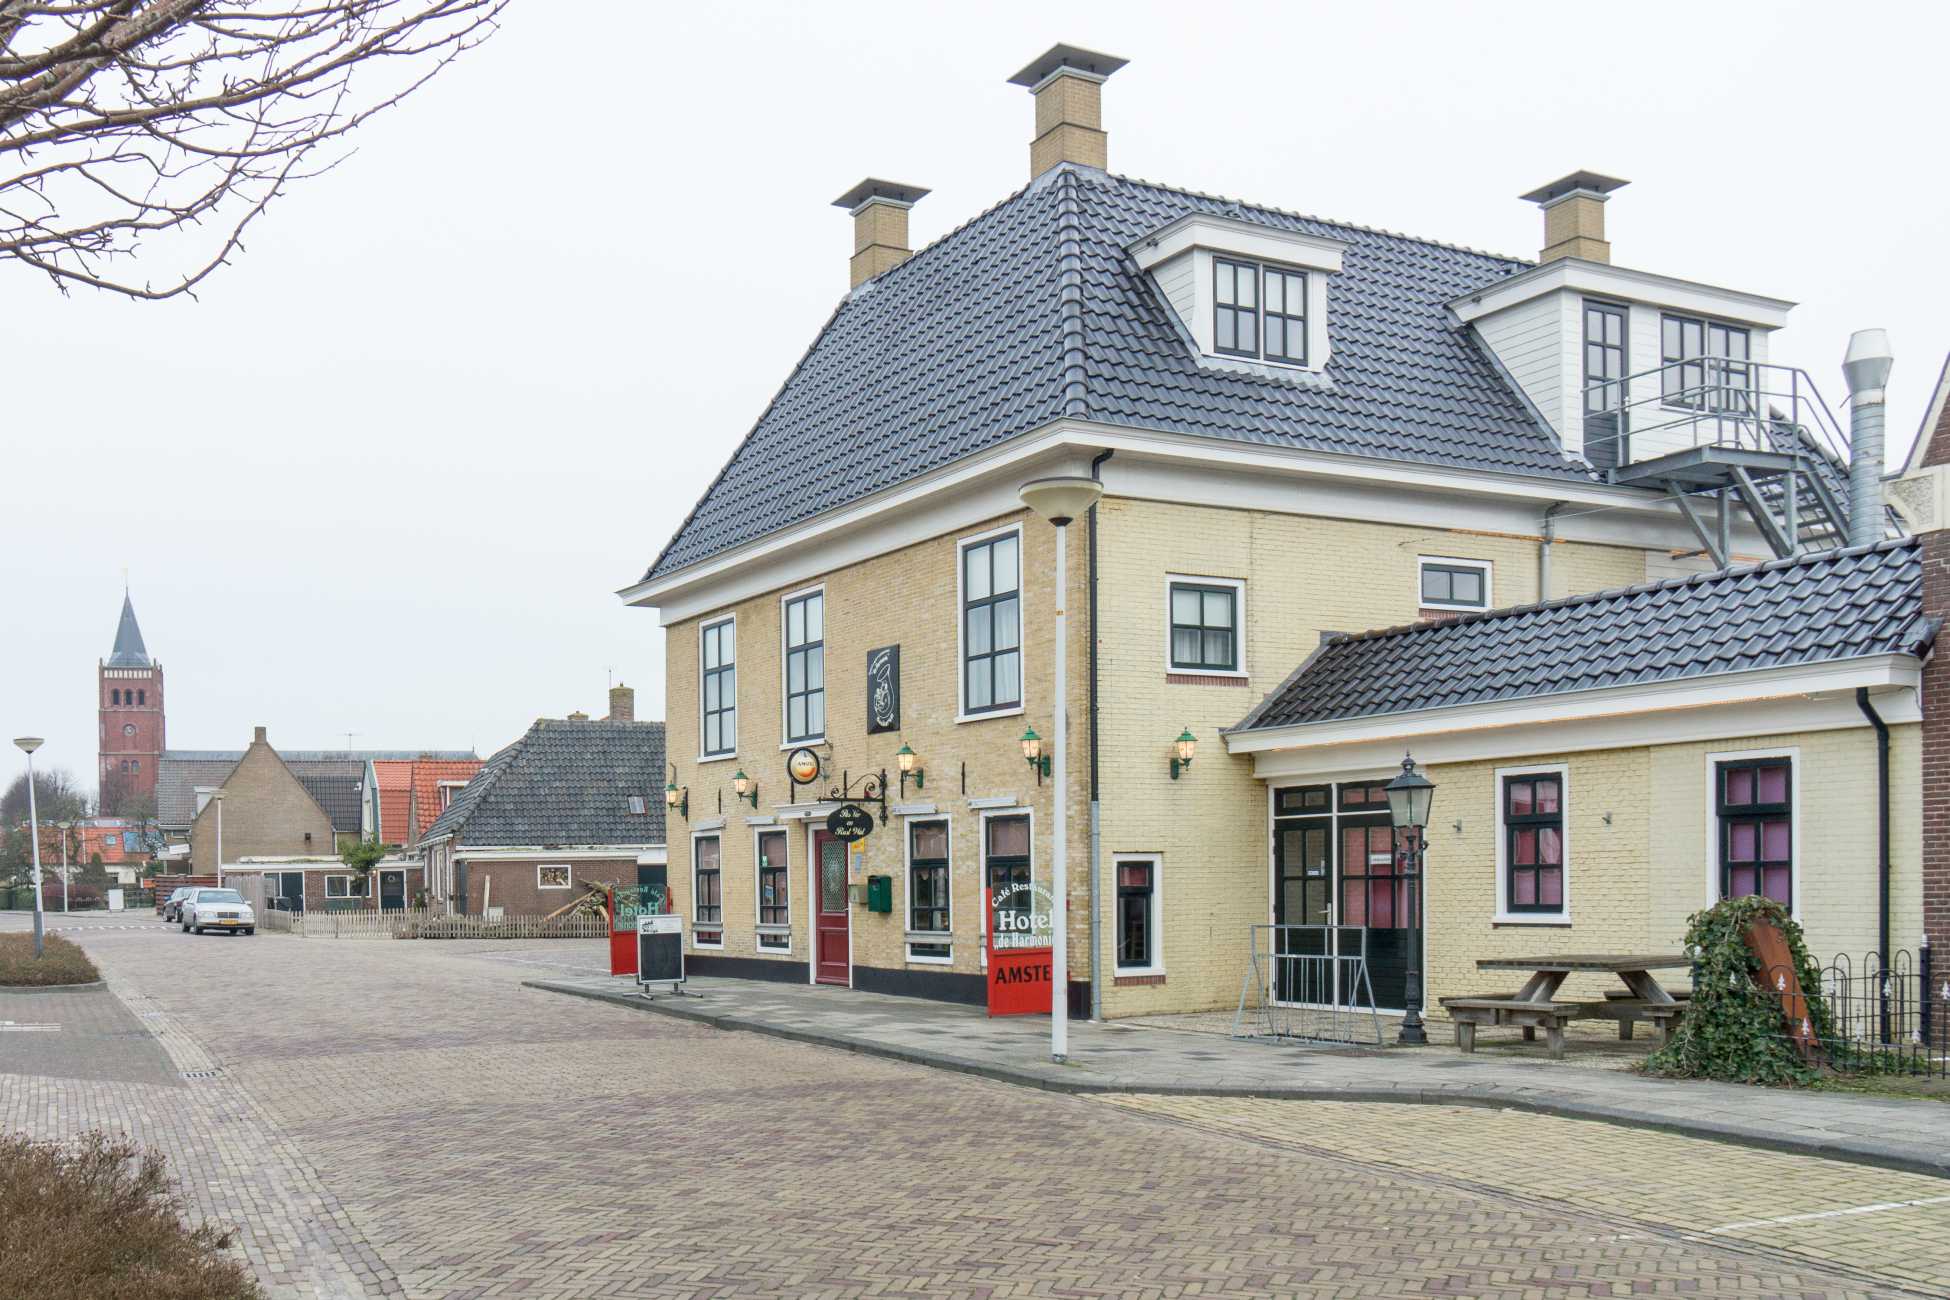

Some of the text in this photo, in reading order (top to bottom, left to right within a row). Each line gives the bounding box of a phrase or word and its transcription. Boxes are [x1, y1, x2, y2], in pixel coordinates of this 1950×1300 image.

[992, 883, 1054, 907] Café Restaura
[999, 910, 1053, 930] Hotel
[1012, 933, 1053, 947] Harmoni
[995, 965, 1051, 985] AMSTE
